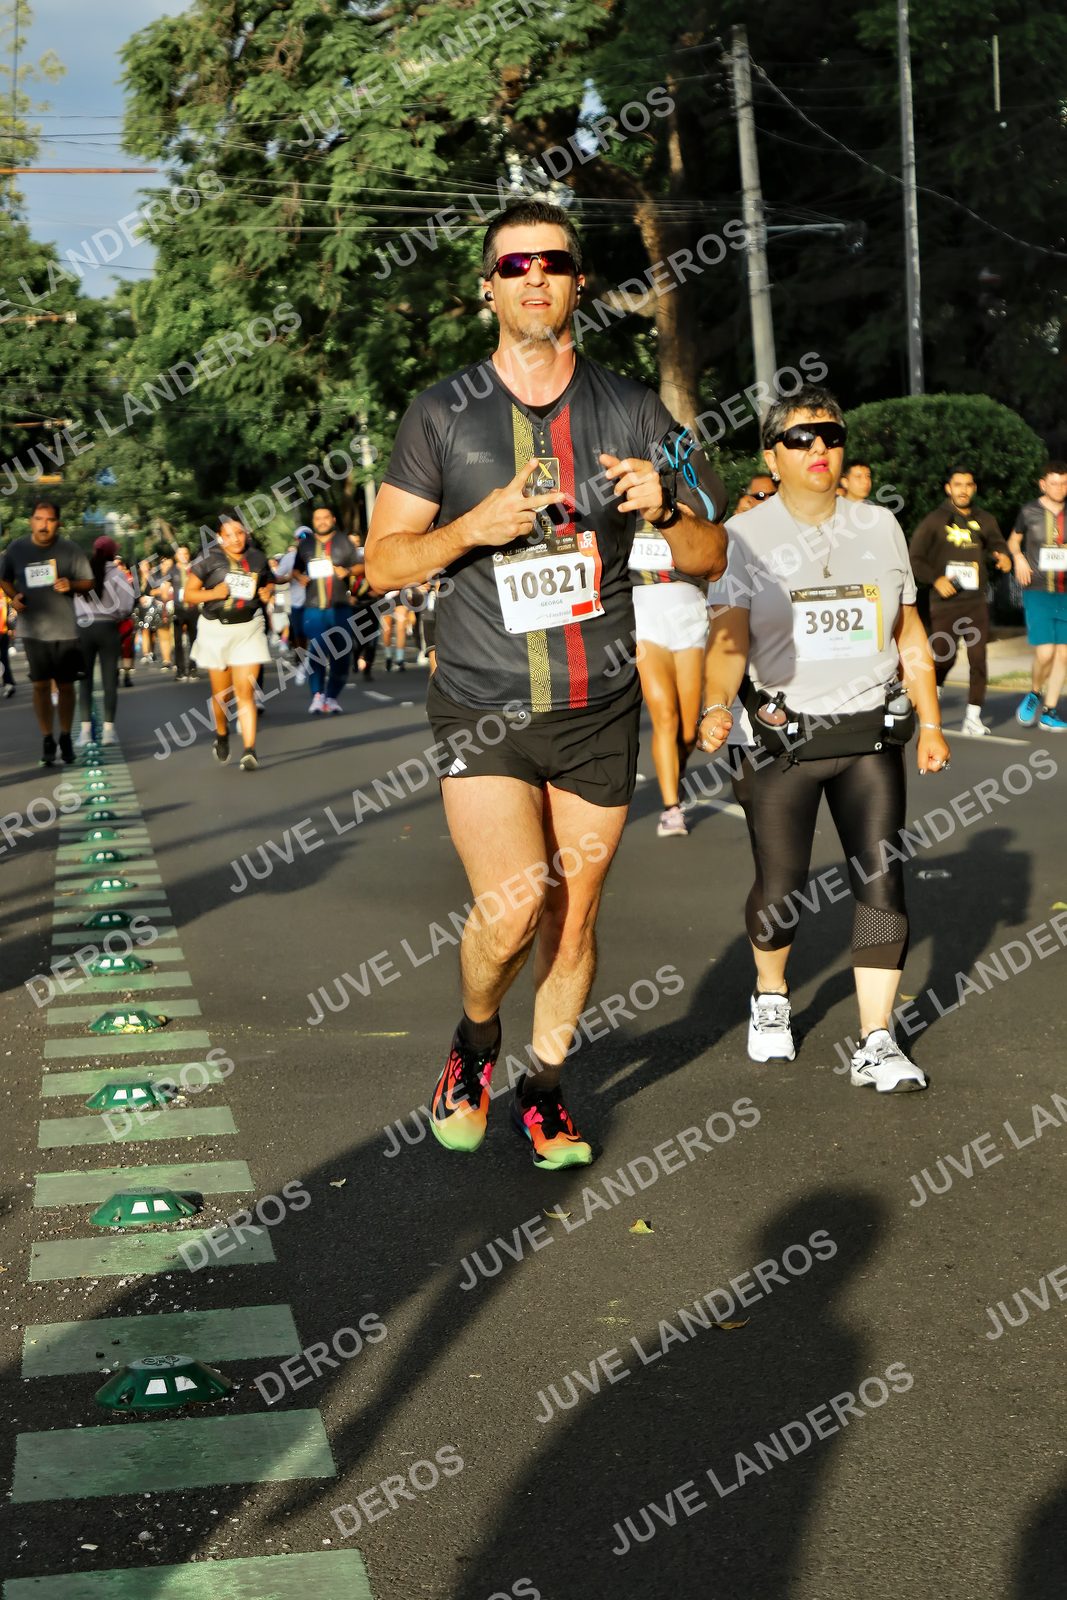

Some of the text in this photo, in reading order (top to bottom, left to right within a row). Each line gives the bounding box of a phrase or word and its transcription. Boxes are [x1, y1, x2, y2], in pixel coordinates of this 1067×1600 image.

[504, 562, 586, 602] 10821
[866, 588, 877, 596] 5K
[806, 608, 864, 634] 3982
